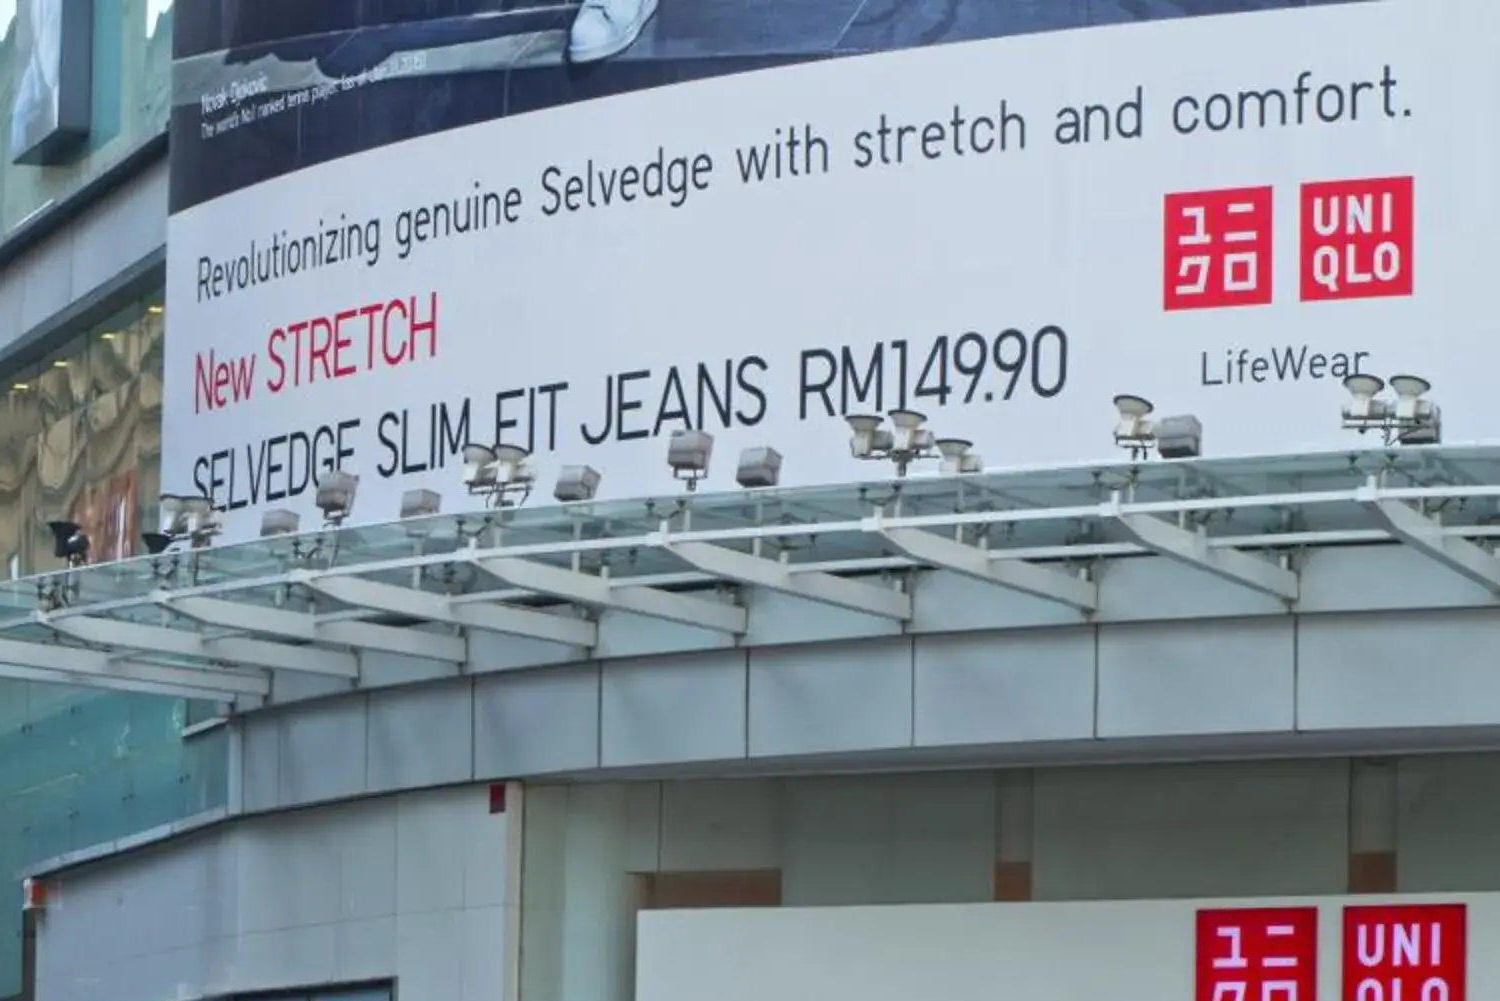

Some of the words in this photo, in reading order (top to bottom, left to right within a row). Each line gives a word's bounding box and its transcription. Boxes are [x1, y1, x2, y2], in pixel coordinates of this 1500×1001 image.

[197, 214, 380, 303] Revolutionizing
[395, 183, 522, 259] genuine
[541, 146, 713, 217] Selvedge
[736, 124, 829, 183] with
[853, 99, 1026, 169] stretch
[1055, 86, 1143, 144] and
[1172, 65, 1412, 134] comfort.
[1312, 191, 1393, 236] UNI
[1312, 242, 1401, 292] QLO
[194, 348, 256, 414] New
[267, 291, 438, 393] STRETCH
[1201, 345, 1370, 387] LifeWear
[192, 418, 361, 514] SELVEDGE
[376, 397, 471, 478] SLIM
[495, 381, 570, 453] FIT
[580, 355, 769, 446] JEANS
[799, 325, 1069, 420] RM149.90
[1357, 922, 1442, 967] UNI
